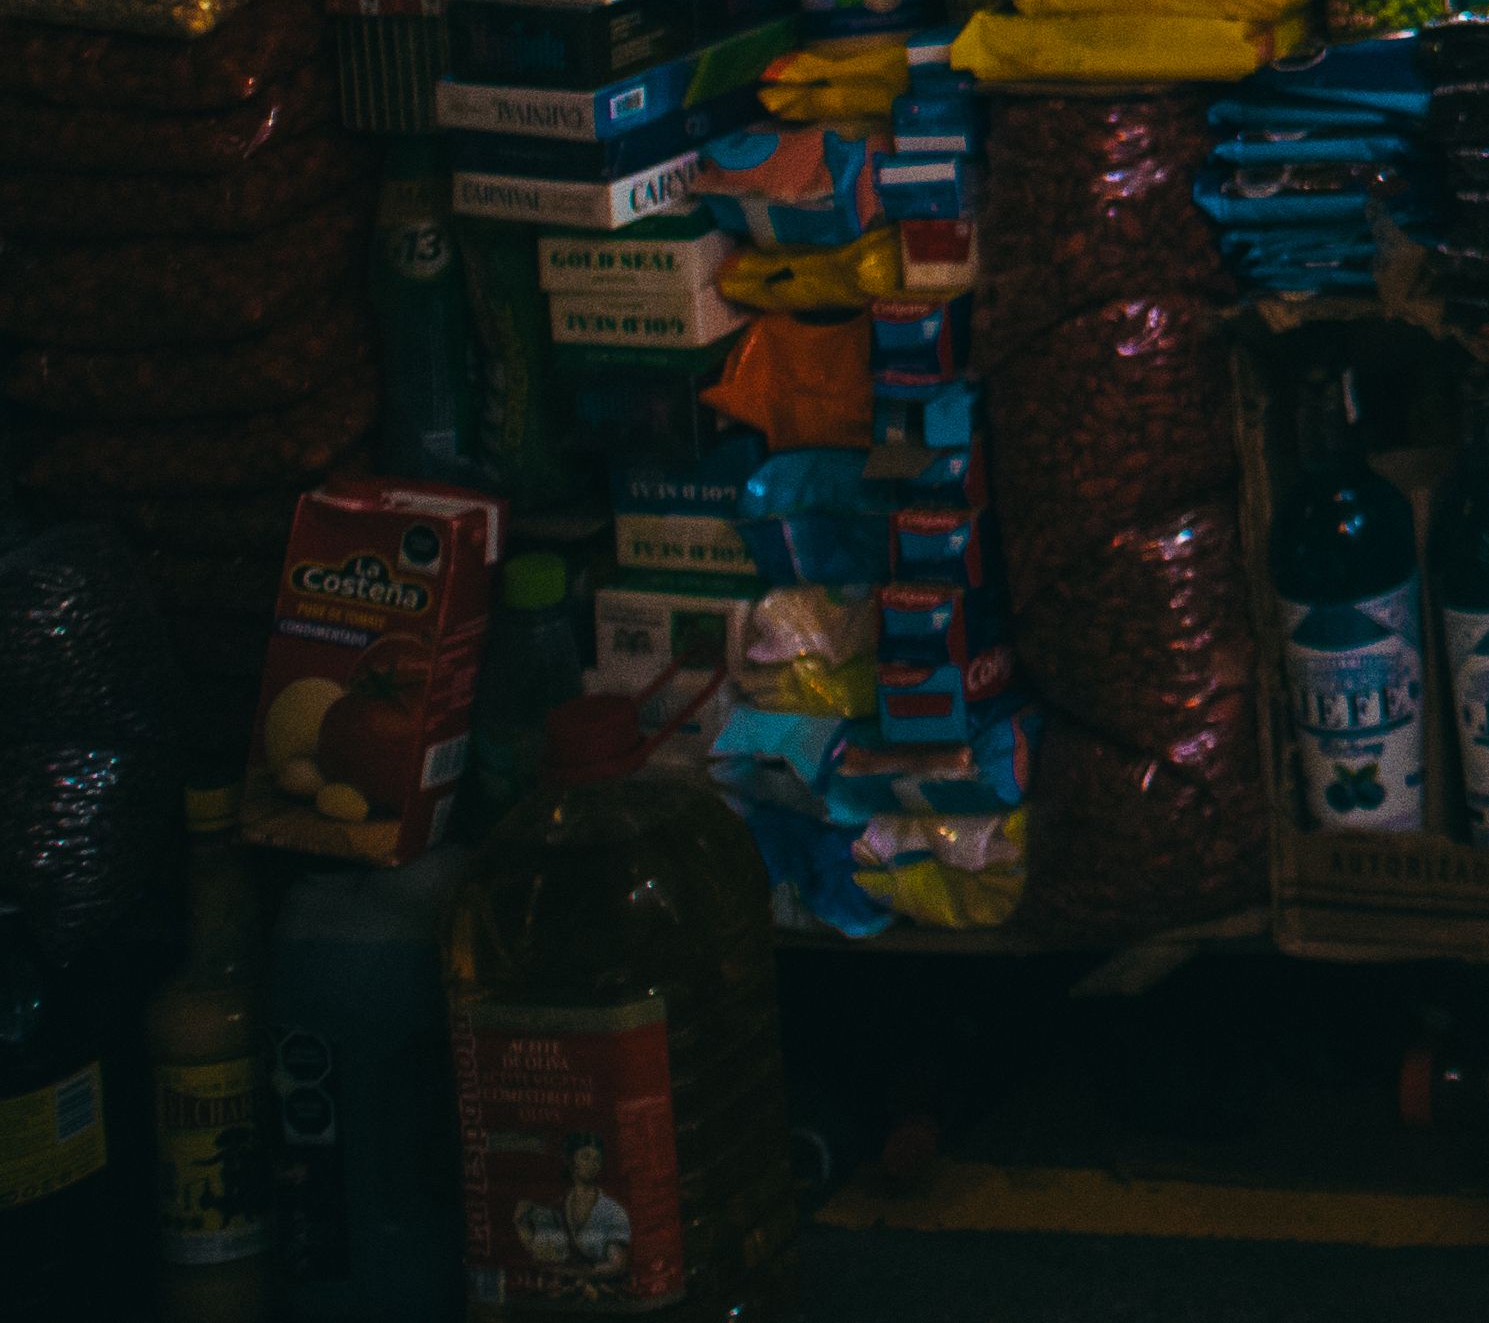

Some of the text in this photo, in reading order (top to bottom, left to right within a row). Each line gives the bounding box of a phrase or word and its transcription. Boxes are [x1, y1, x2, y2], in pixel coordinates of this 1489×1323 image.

[462, 182, 541, 212] CARNIVAL
[549, 250, 680, 272] GOLD SEAL
[356, 556, 380, 578] La
[301, 563, 422, 610] Costeña
